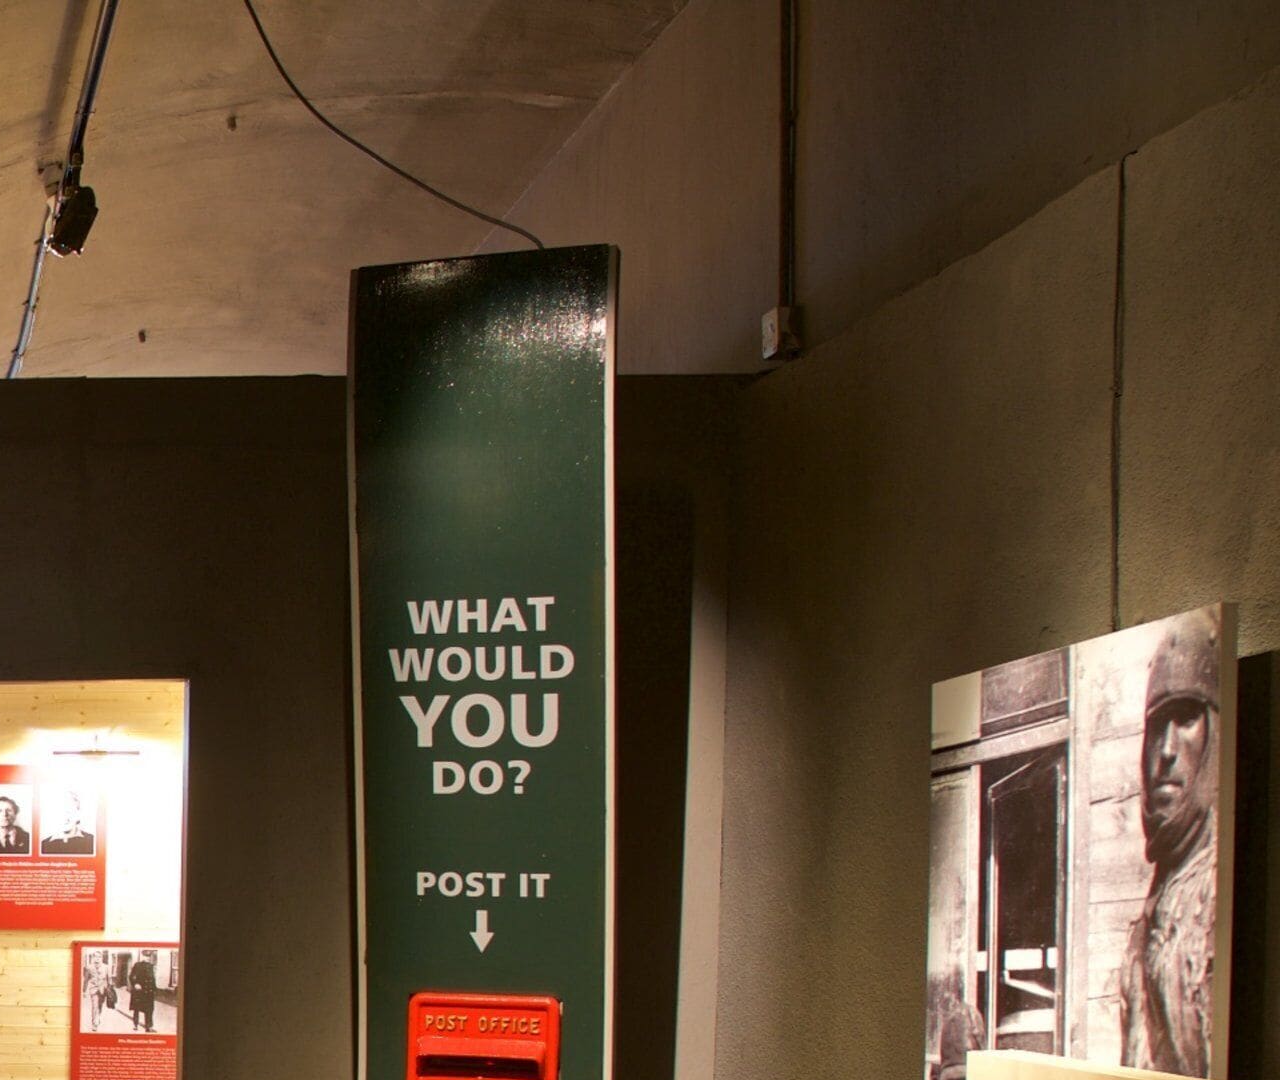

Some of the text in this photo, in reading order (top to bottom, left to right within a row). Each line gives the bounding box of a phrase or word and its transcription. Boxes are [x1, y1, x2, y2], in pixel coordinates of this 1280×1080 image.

[406, 596, 555, 635] WHAT
[388, 644, 575, 682] WOULD
[399, 693, 559, 748] YOU
[432, 760, 531, 795] DO?
[416, 871, 551, 898] POST IT
[425, 1015, 541, 1034] POST OFFICE
